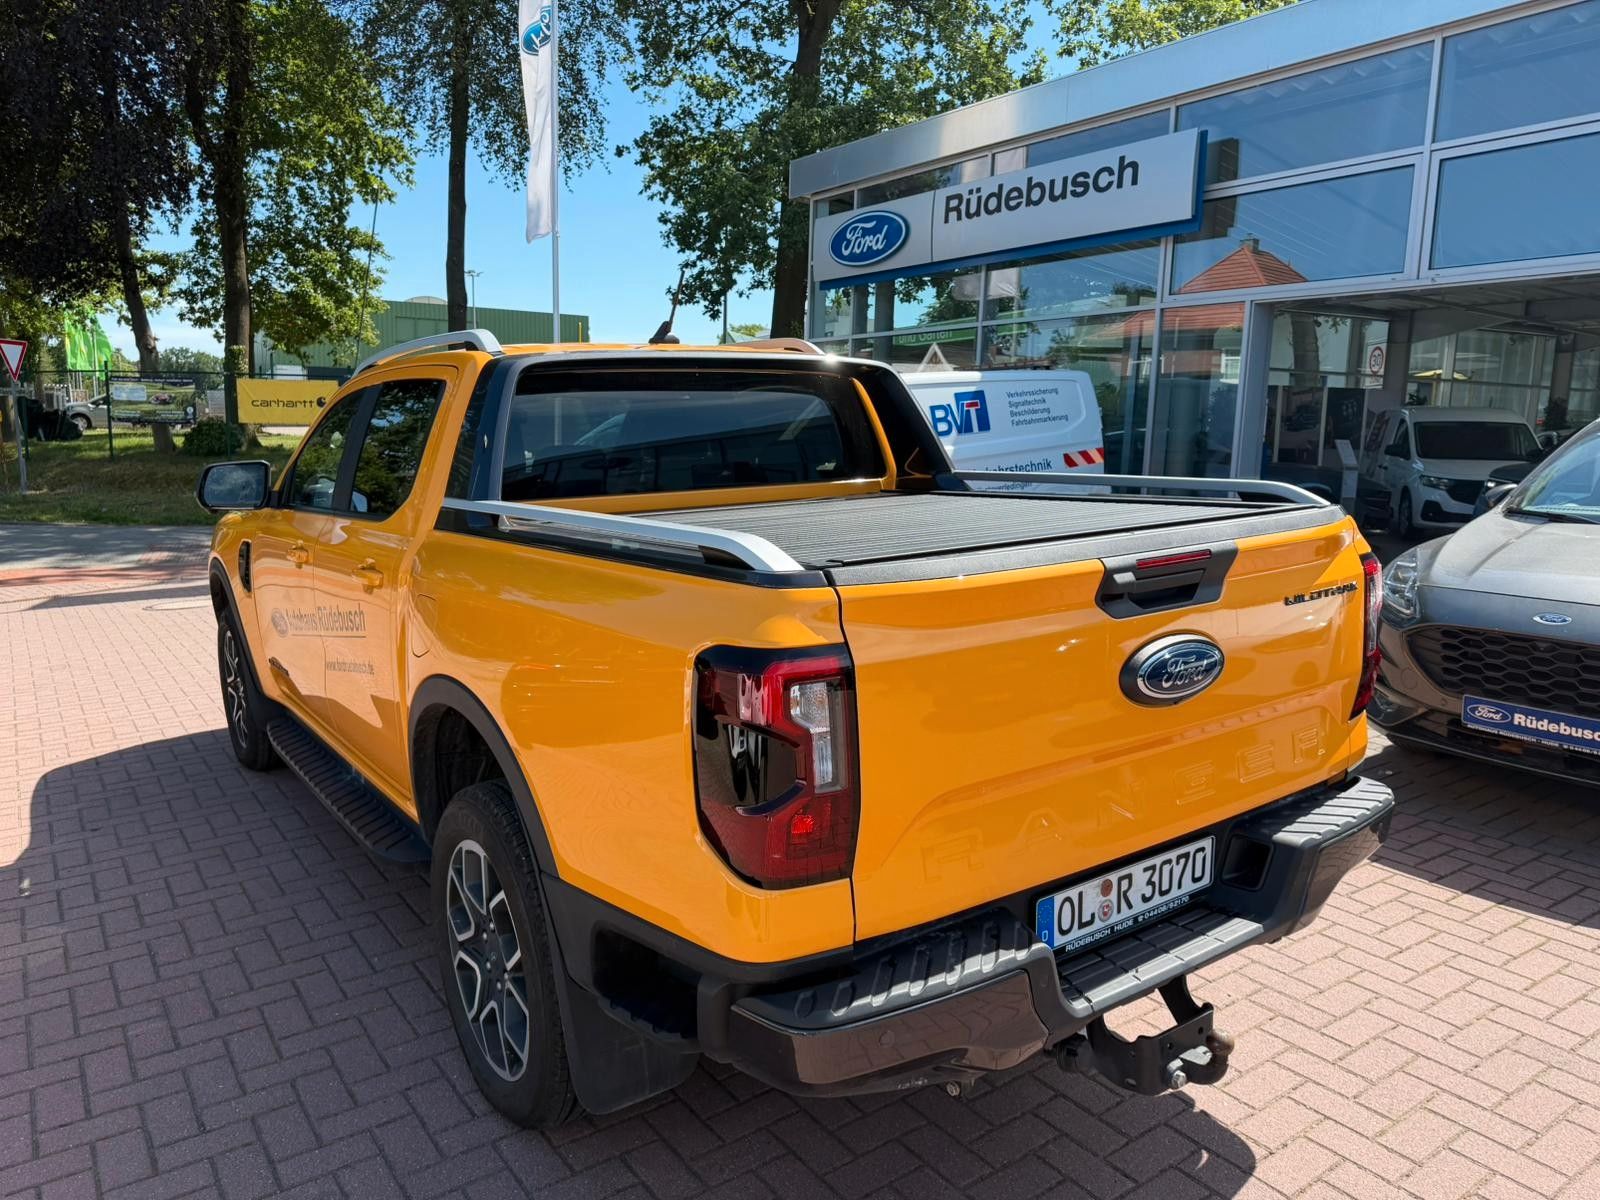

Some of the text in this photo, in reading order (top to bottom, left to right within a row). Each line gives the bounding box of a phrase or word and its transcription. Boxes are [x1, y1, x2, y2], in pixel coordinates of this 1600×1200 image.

[944, 155, 1139, 224] Rüdebusch
[841, 221, 887, 256] Ford
[251, 398, 314, 408] carhartt
[930, 400, 981, 436] BVT
[1162, 655, 1207, 688] Ford
[1475, 706, 1502, 720] Ford
[1057, 847, 1207, 936] OL R 3070
[1042, 930, 1049, 942] D
[1065, 929, 1111, 953] RÜDEBUSCH
[1114, 918, 1134, 932] HUDE
